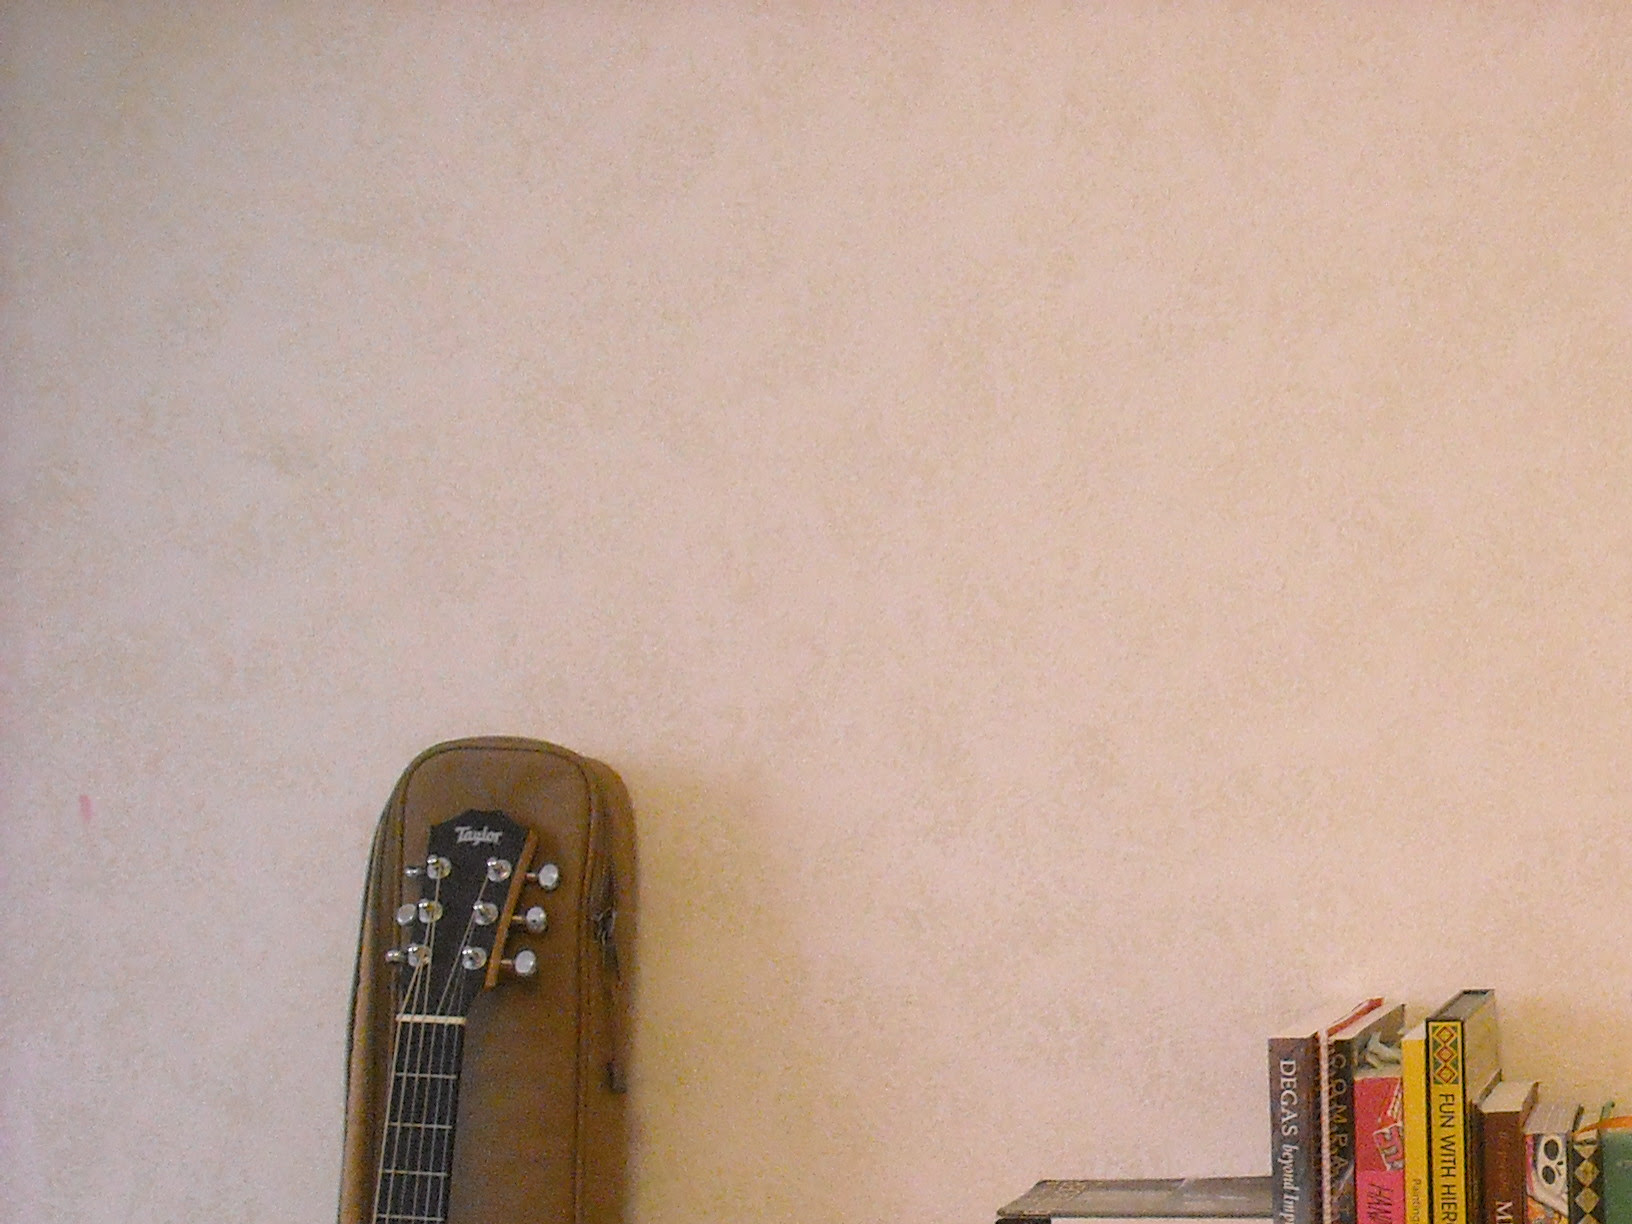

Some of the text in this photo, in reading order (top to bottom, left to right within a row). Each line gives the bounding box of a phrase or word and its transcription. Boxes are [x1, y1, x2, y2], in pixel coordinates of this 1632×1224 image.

[454, 825, 504, 846] Taylor
[1279, 1059, 1299, 1138] DEGAS
[1438, 1093, 1457, 1129] FUN
[1277, 1143, 1300, 1193] beyond
[1439, 1133, 1457, 1178] WITH
